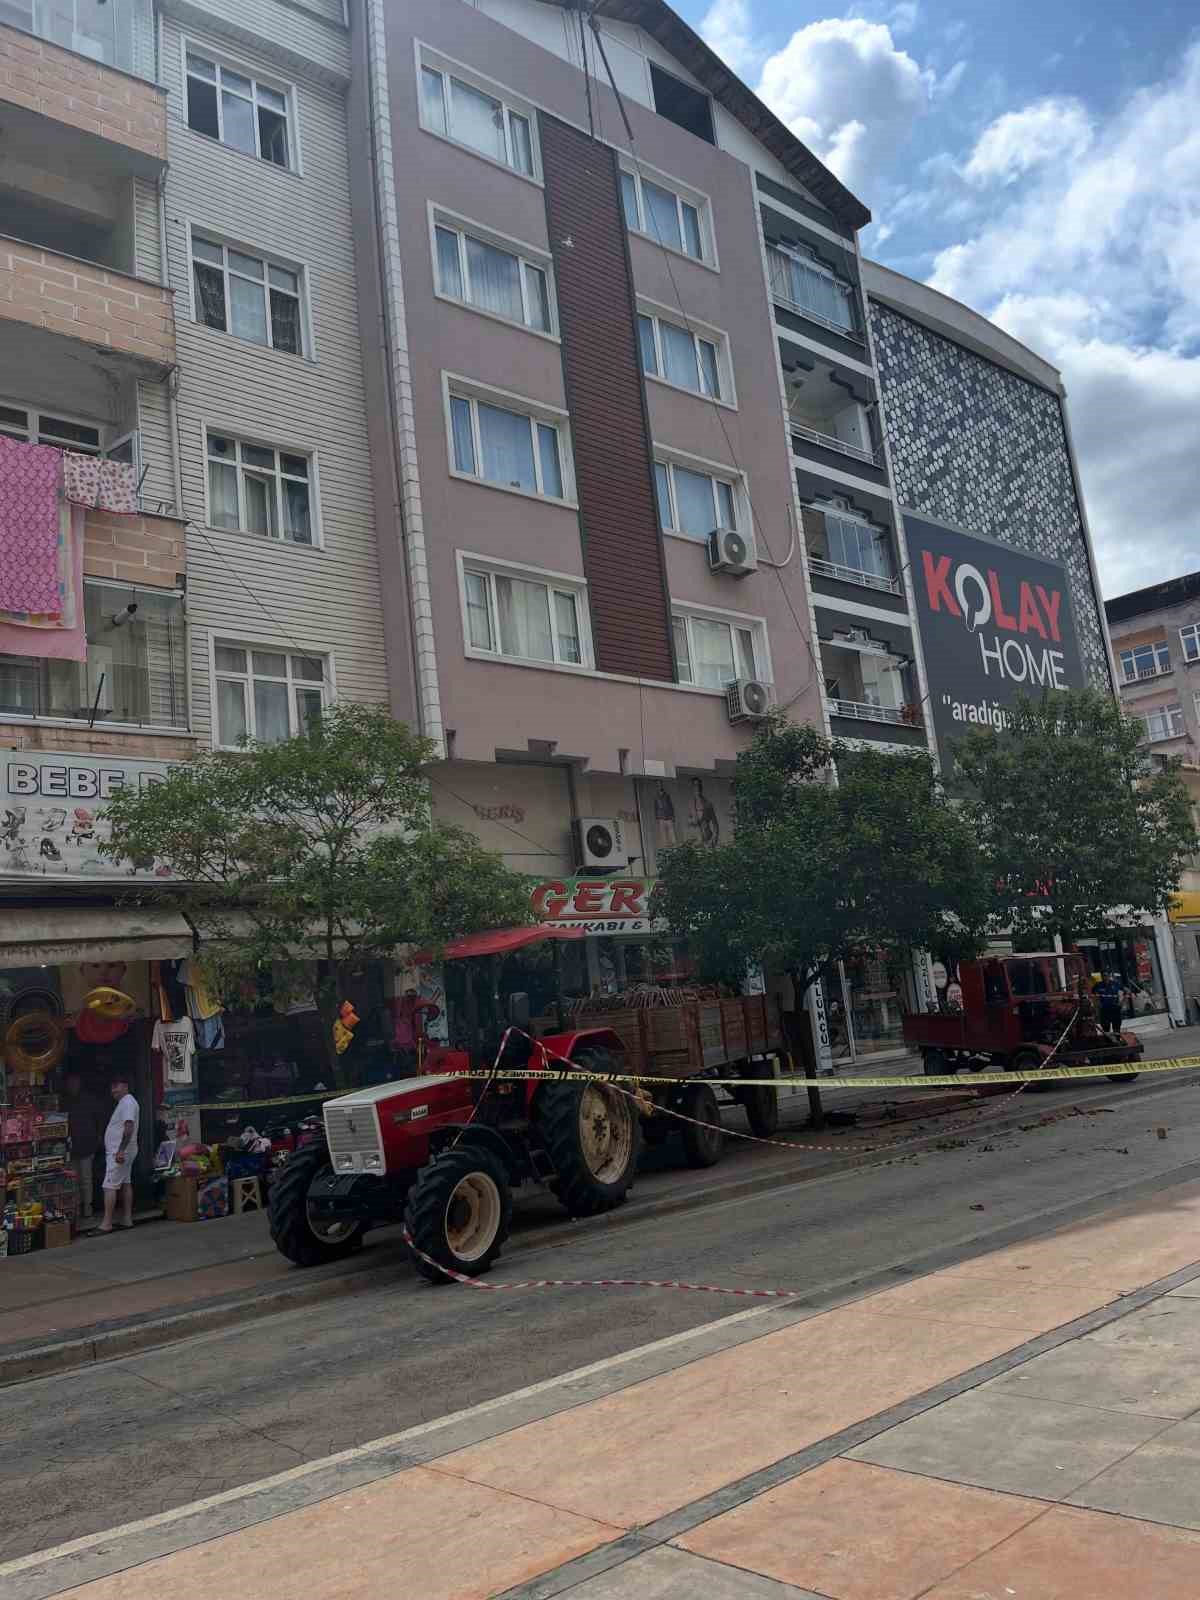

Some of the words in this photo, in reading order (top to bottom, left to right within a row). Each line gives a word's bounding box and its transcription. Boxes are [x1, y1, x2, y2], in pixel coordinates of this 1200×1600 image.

[922, 550, 1061, 641] KOLAY
[979, 632, 1070, 691] HOME
[7, 763, 125, 800] BEBE
[631, 921, 644, 930] &
